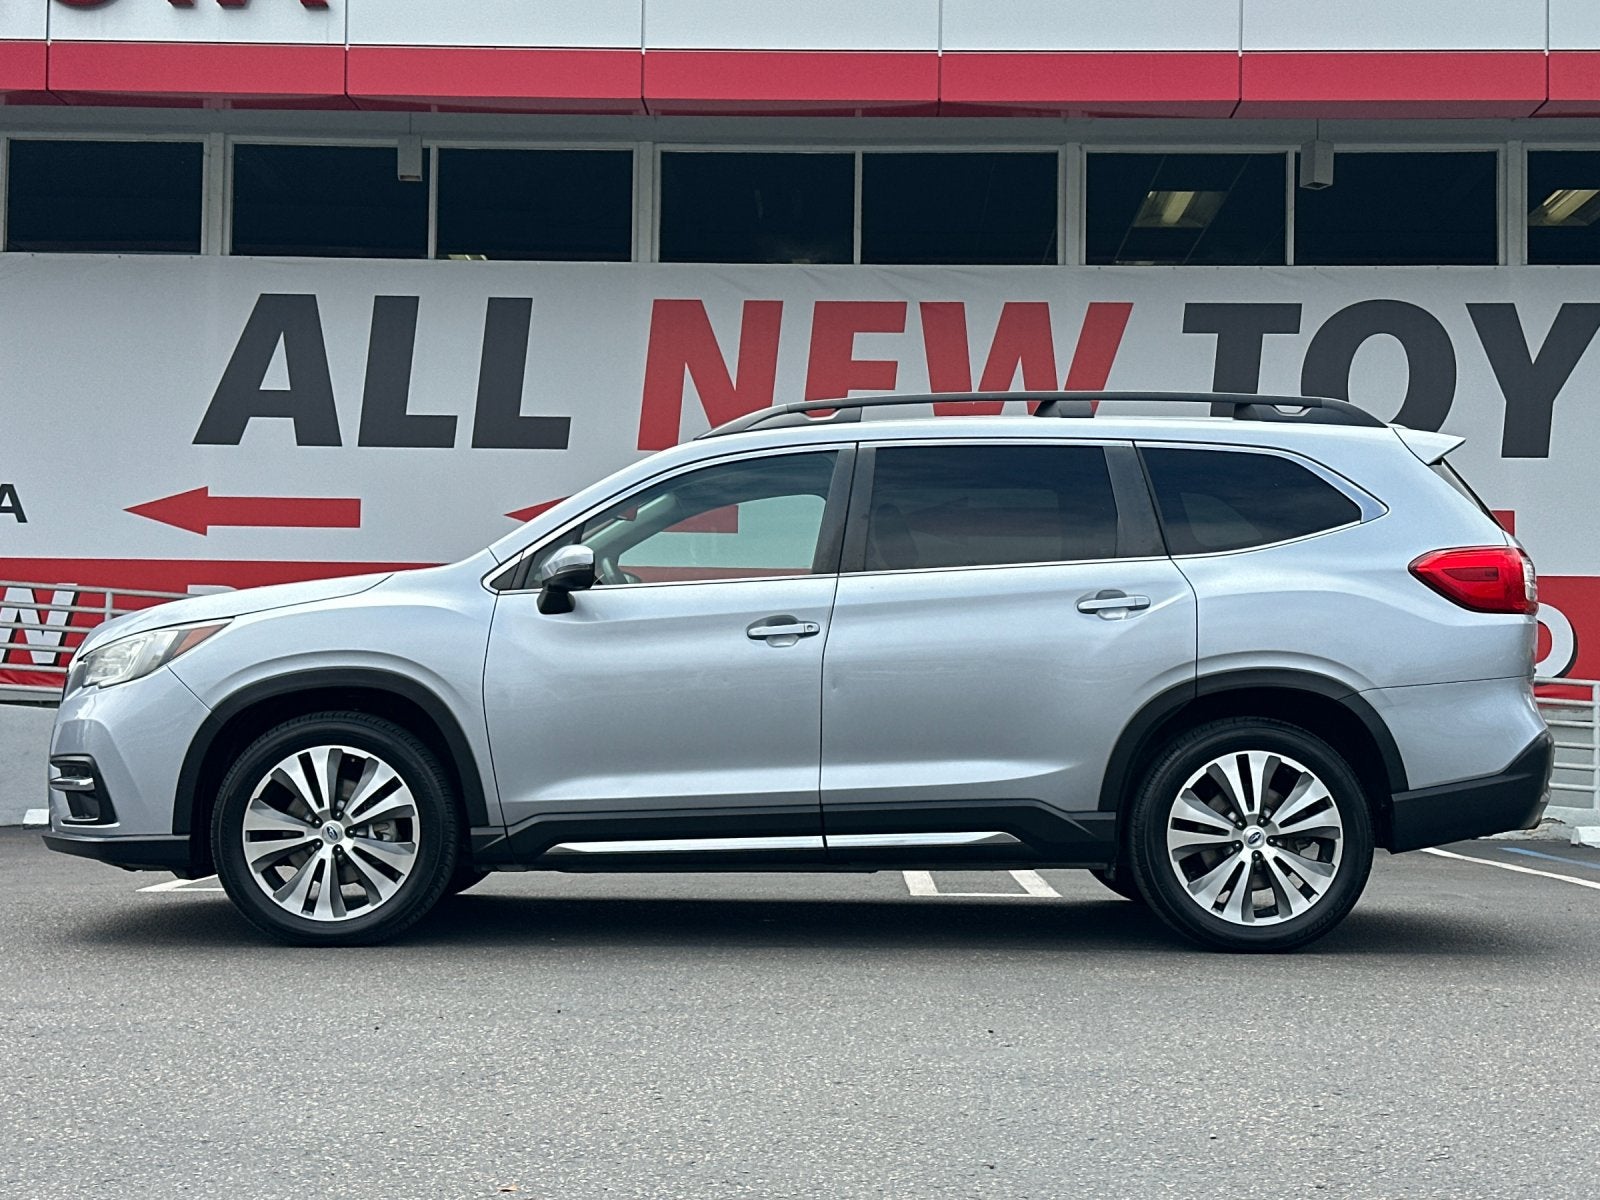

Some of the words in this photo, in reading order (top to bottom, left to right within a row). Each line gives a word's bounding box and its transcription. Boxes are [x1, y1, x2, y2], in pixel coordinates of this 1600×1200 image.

[192, 293, 572, 450] ALL
[637, 298, 1134, 451] NEW
[1182, 299, 1600, 458] TOY
